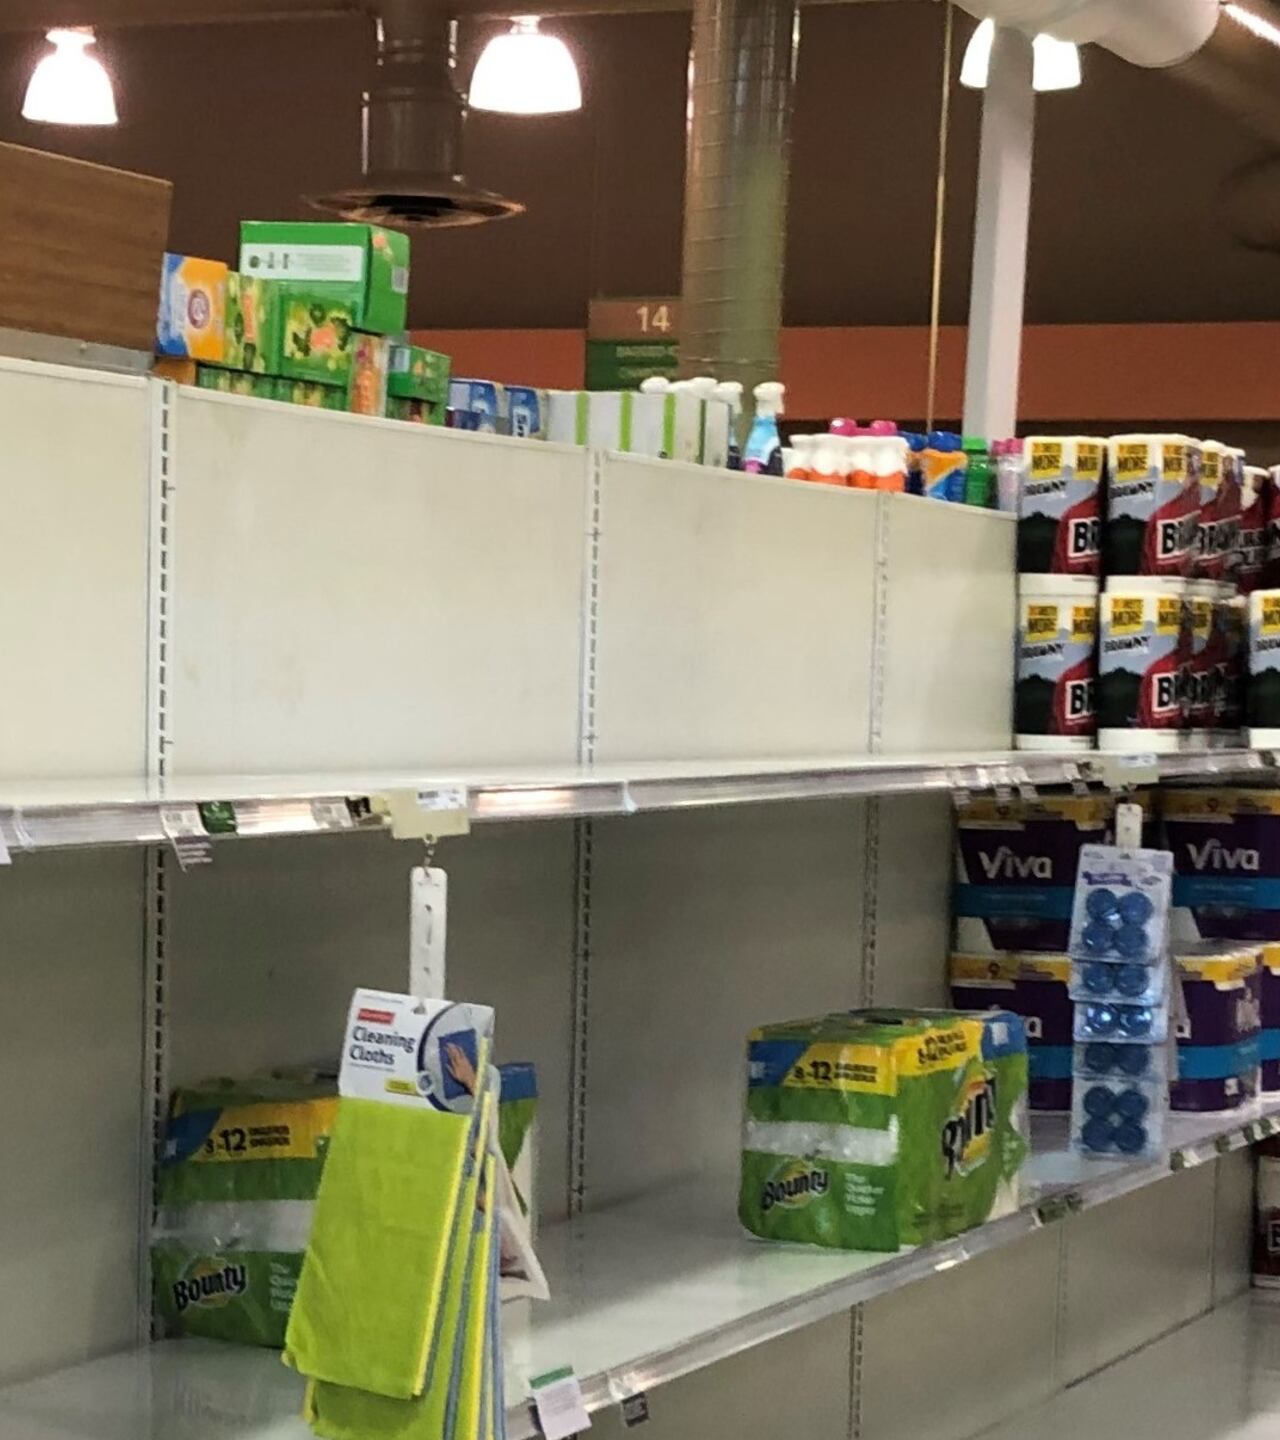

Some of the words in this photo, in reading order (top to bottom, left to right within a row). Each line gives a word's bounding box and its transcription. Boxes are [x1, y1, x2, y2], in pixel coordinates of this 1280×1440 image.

[636, 305, 671, 332] 14
[978, 846, 1053, 880] Viva
[1187, 838, 1260, 871] Viva
[353, 1025, 416, 1054] Cleaning
[349, 1044, 396, 1066] Cloths
[810, 1060, 832, 1082] 12
[219, 1127, 247, 1152] 12
[762, 1168, 829, 1211] Bounty
[173, 1264, 246, 1312] Bounty
